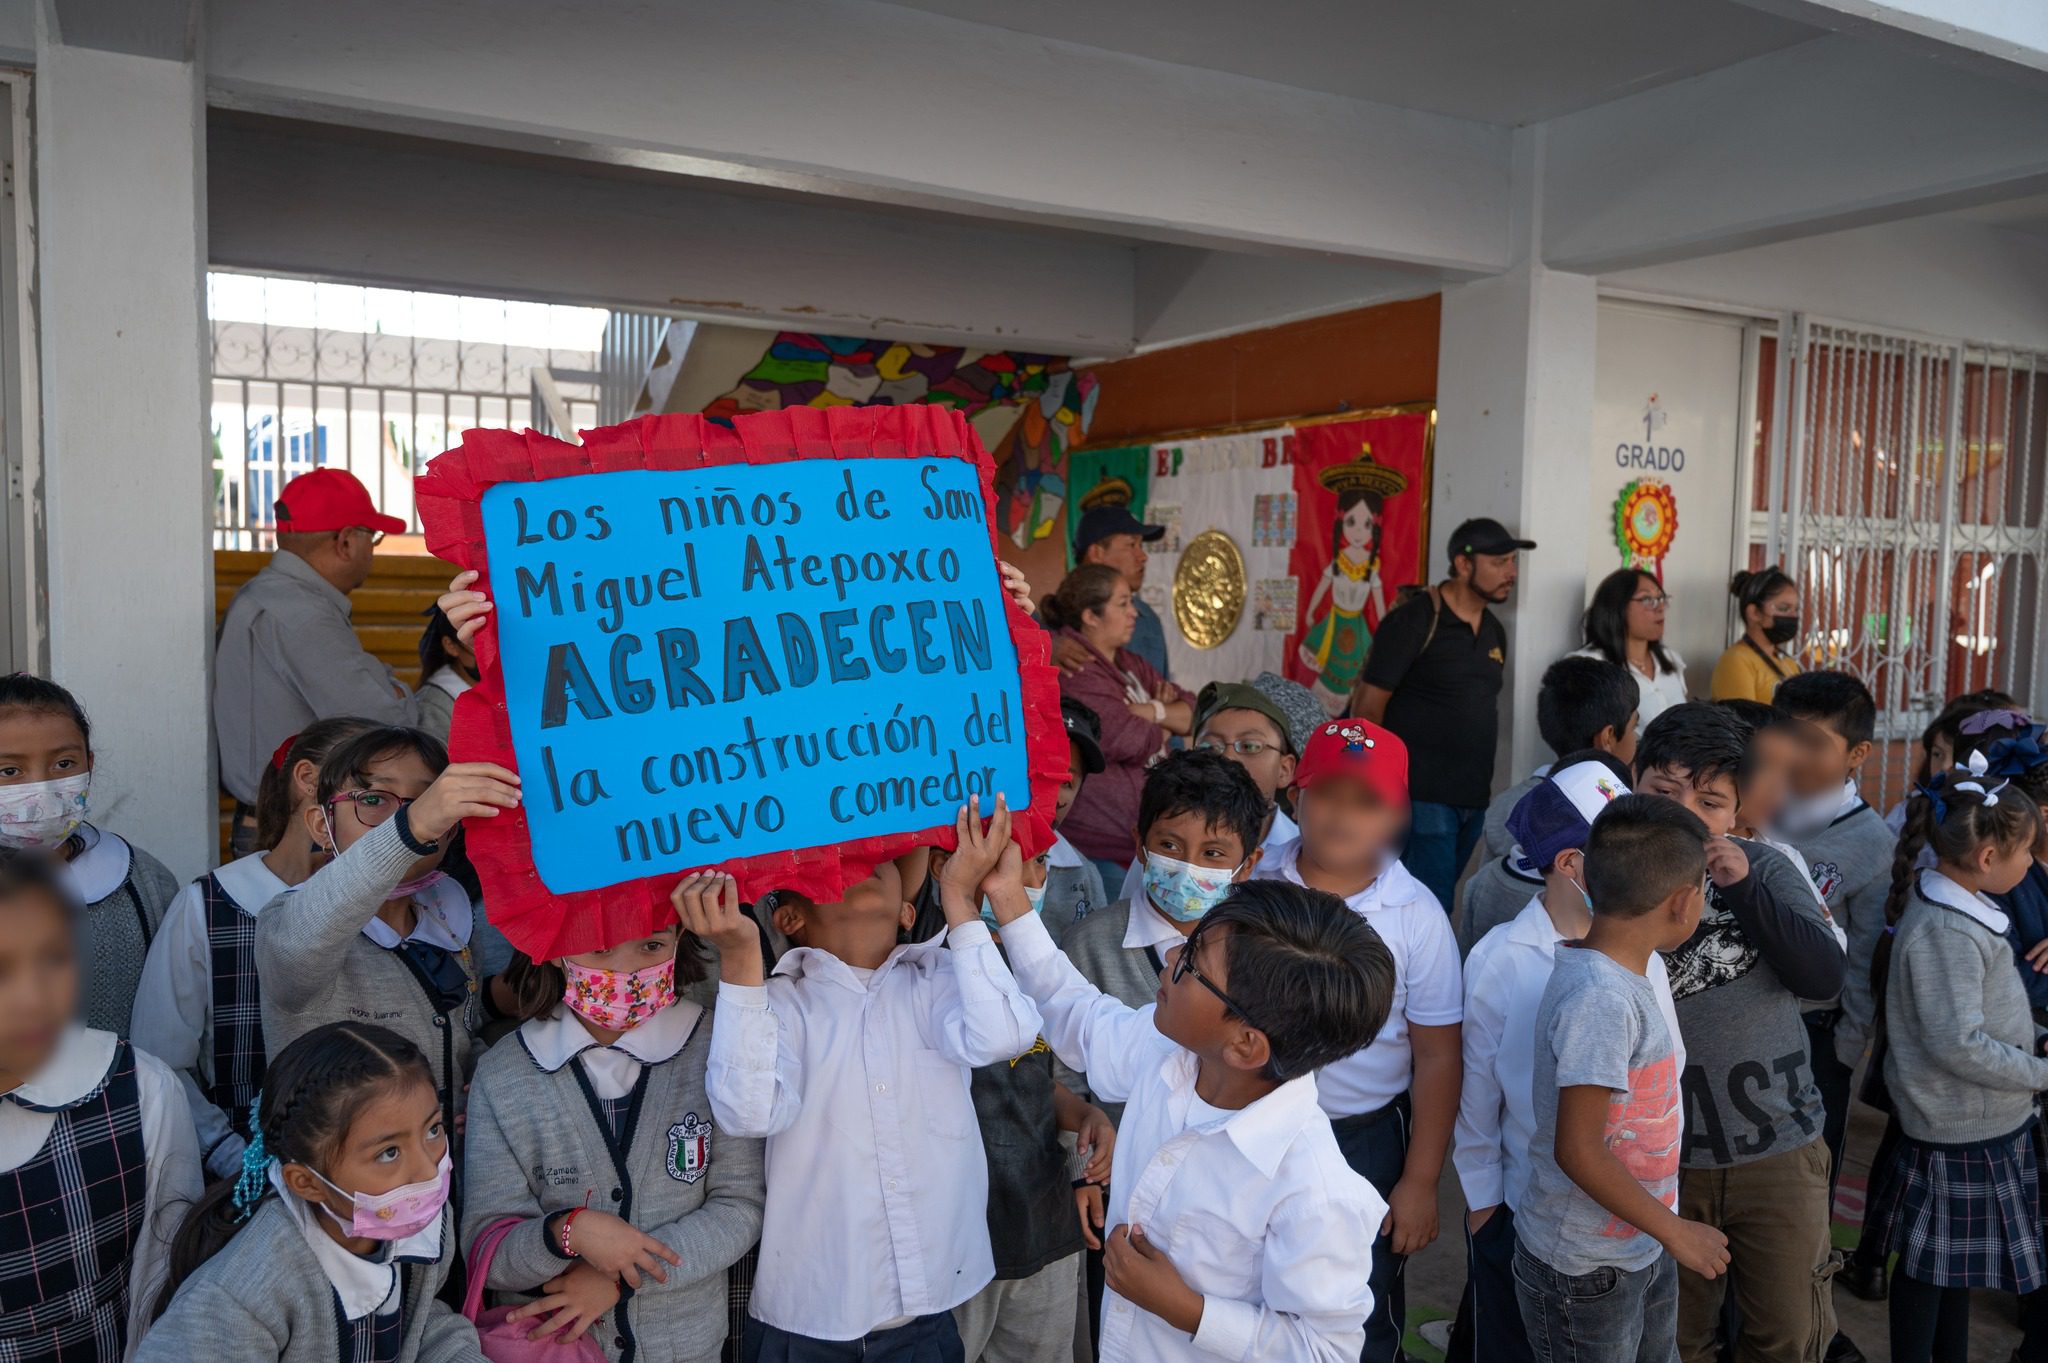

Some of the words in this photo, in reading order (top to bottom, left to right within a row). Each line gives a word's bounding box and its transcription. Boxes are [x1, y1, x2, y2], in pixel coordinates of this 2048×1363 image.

[515, 497, 612, 546] Los
[659, 486, 801, 535] niños
[836, 467, 891, 522] de
[921, 464, 981, 524] San
[1615, 443, 1685, 472] GRADO
[514, 542, 701, 634] Miguel
[741, 534, 961, 601] Atepoxco
[541, 598, 994, 728] AGRADECEN
[541, 745, 612, 812] la
[641, 703, 938, 795] construcción
[963, 690, 1011, 747] del
[615, 794, 785, 862] nuevo
[829, 749, 997, 823] comedor
